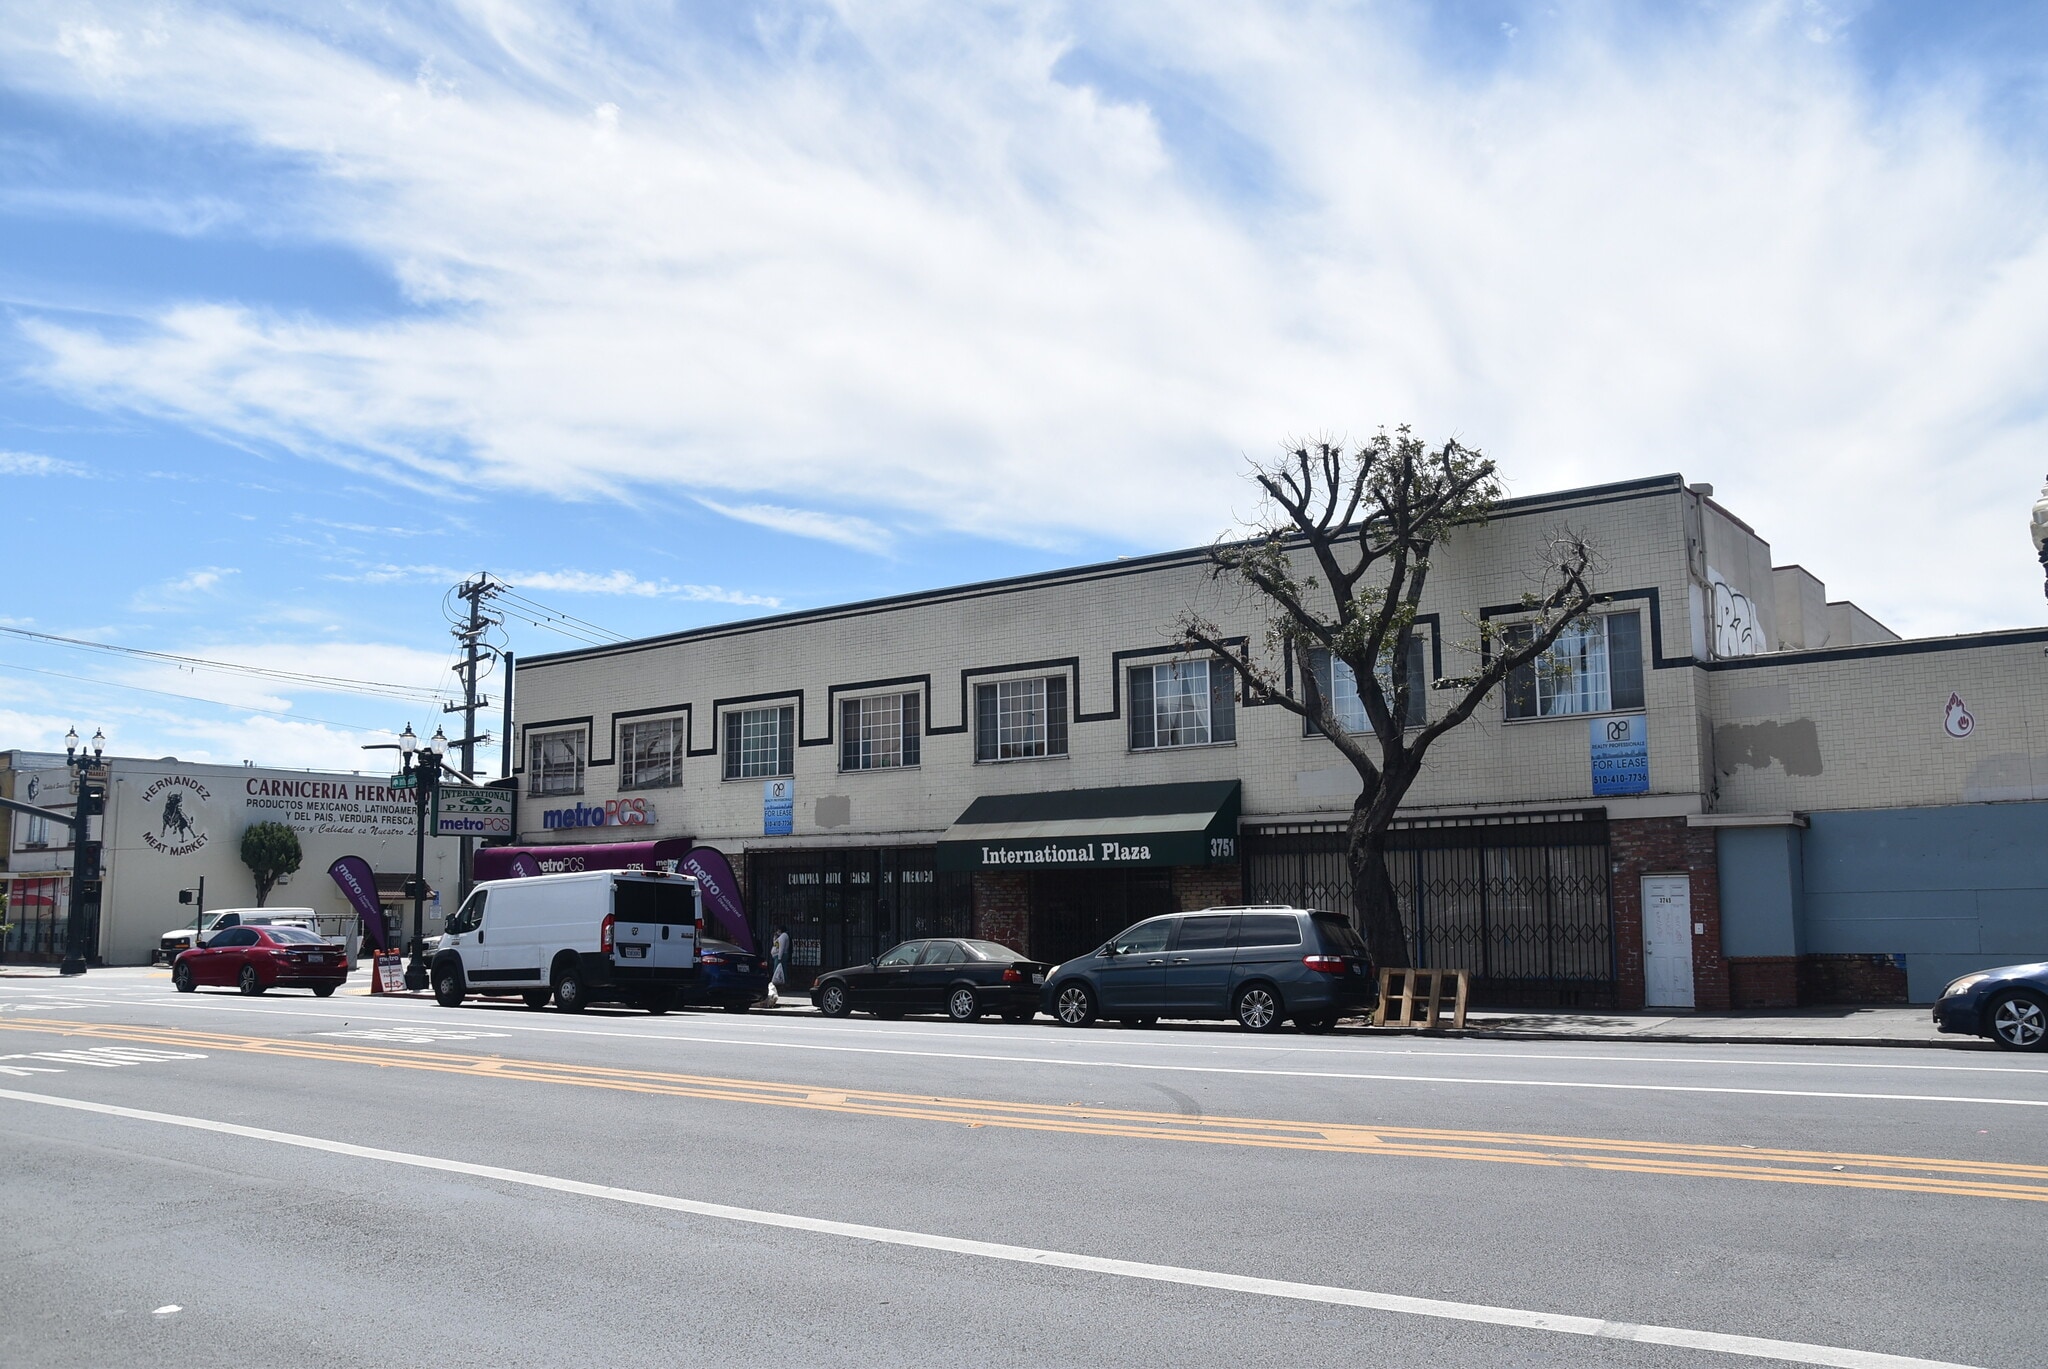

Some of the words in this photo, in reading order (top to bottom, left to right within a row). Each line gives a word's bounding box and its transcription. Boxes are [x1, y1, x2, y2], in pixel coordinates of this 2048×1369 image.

[1593, 760, 1613, 769] FOR
[1617, 758, 1646, 768] LEASE
[1594, 773, 1647, 784] 510-410-7736
[142, 776, 211, 802] HERNANDEZ
[246, 778, 348, 800] CARNICERIA
[440, 789, 511, 803] INTERNATIONAL
[246, 799, 303, 810] PRODUCTOS
[306, 802, 362, 814] MEXICANOS,
[445, 804, 505, 813] PLAZA
[543, 798, 647, 830] metroPCS
[777, 809, 792, 817] LEASE
[286, 812, 292, 820] Y
[294, 812, 311, 821] DEL
[314, 812, 336, 823] PAIS,
[339, 814, 378, 824] VERDURA
[381, 816, 417, 826] FRESCA.
[440, 817, 510, 832] metroPCS
[318, 823, 354, 834] Calidad
[370, 825, 404, 836] Nuestro
[142, 831, 168, 854] MEAT
[170, 832, 209, 856] MARKET
[1210, 838, 1234, 858] 3751
[981, 844, 1095, 864] International
[1101, 842, 1151, 861] Plaza
[338, 864, 362, 895] metro
[686, 858, 720, 896] metro
[720, 895, 742, 918] Authorized
